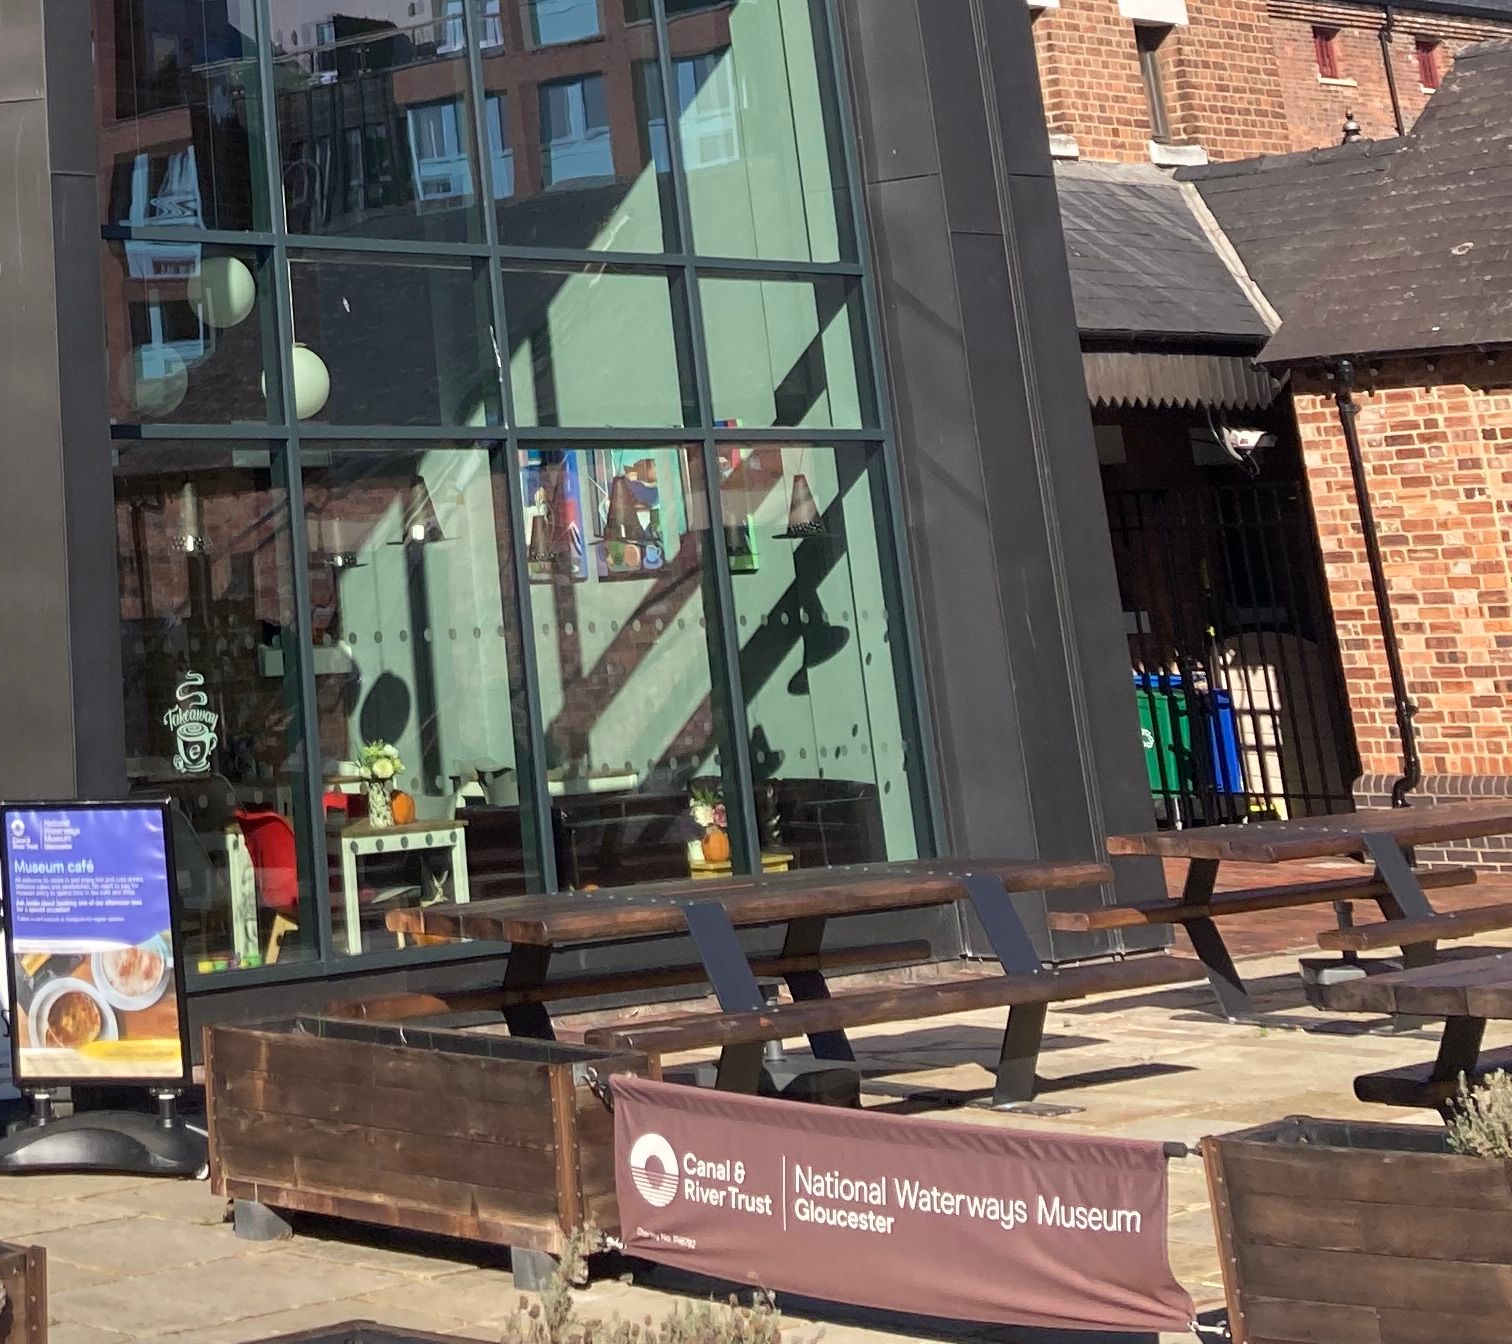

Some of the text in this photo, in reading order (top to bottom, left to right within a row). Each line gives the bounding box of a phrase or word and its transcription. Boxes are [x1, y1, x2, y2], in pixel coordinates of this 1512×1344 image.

[163, 704, 219, 732] Takeaway
[14, 857, 95, 874] Museum café
[683, 1152, 746, 1185] Canal &
[683, 1178, 773, 1216] River Trust
[794, 1164, 1143, 1234] National Waterways Museum
[794, 1200, 895, 1235] Gloucester
